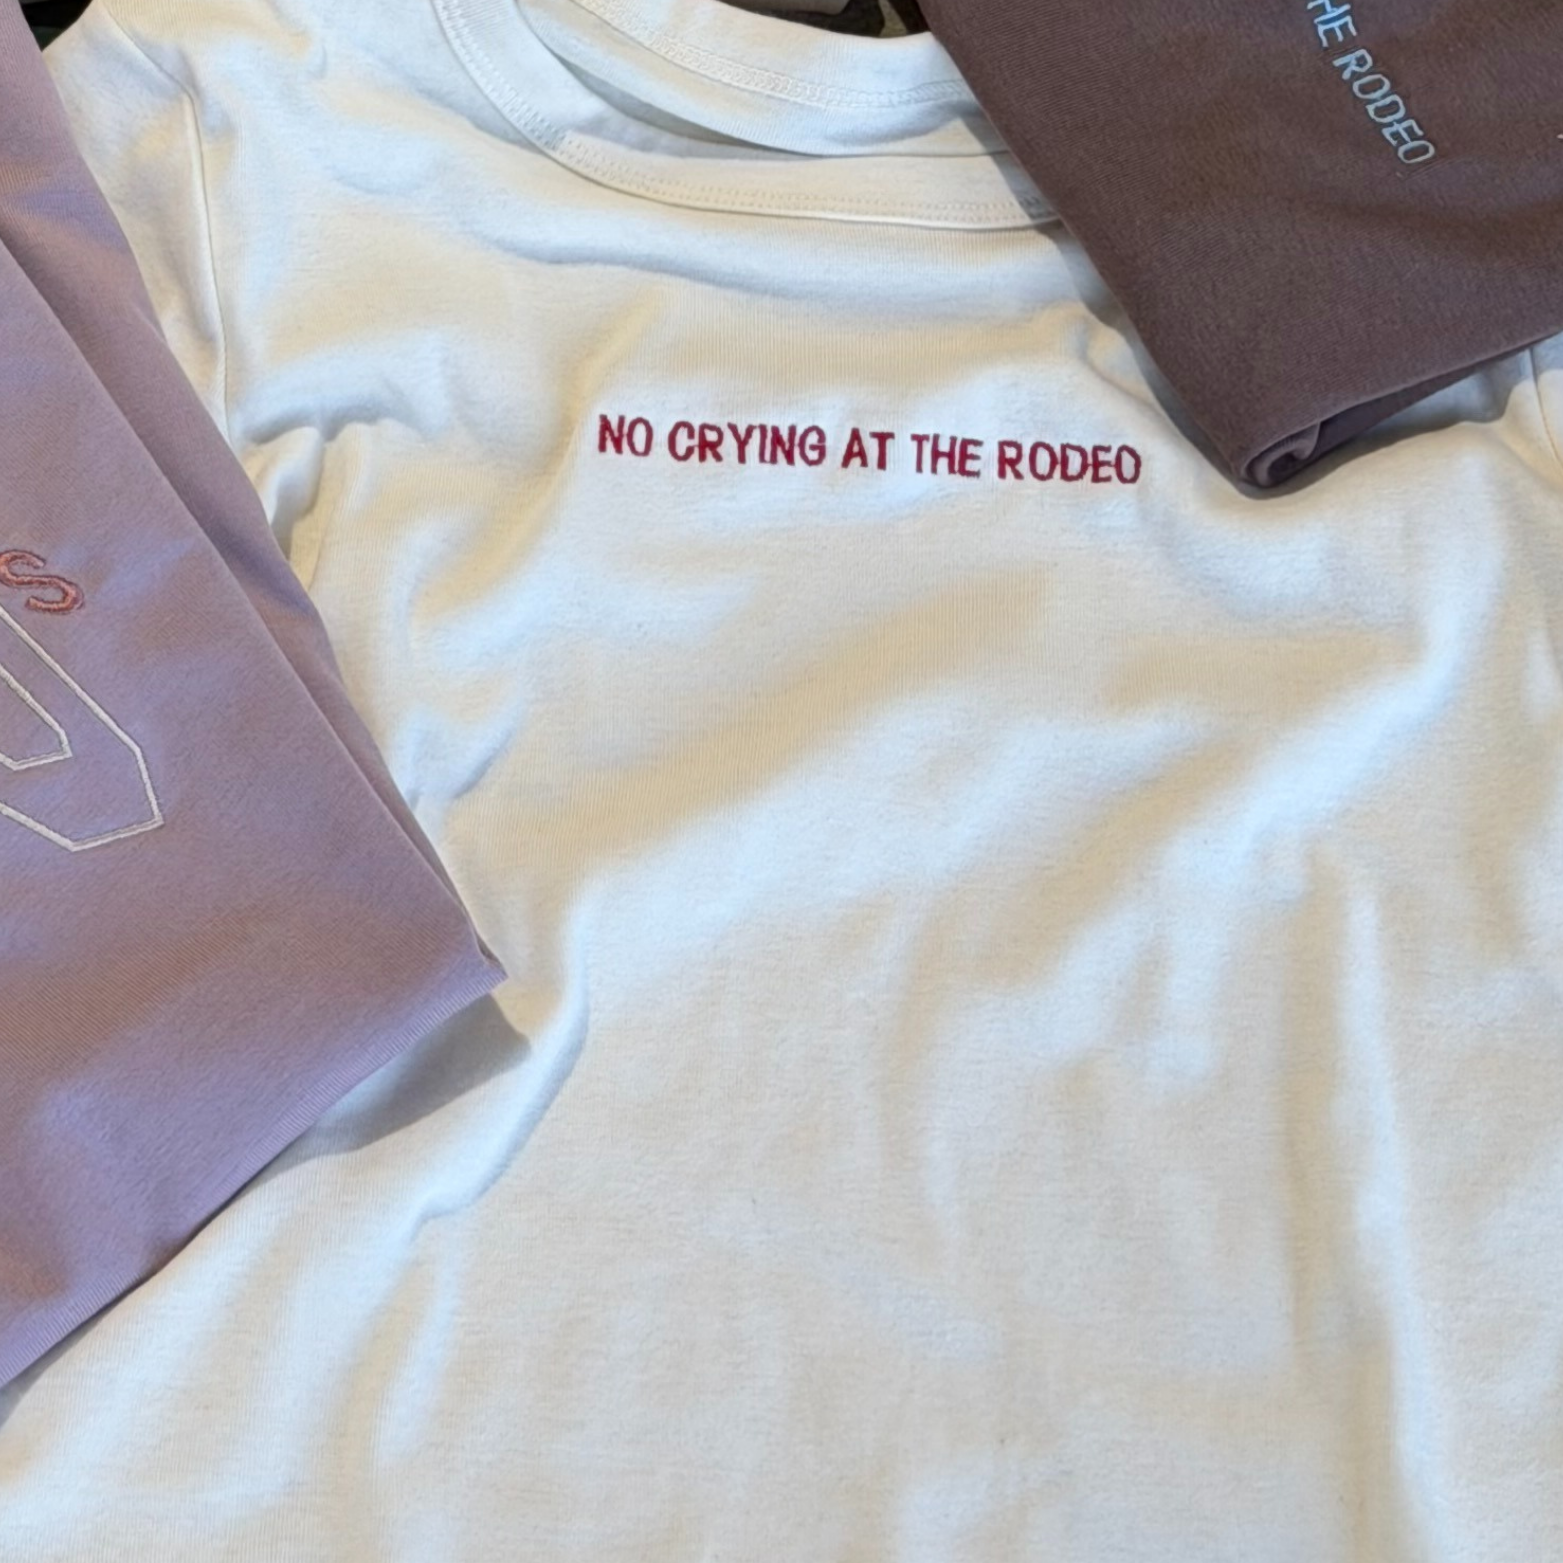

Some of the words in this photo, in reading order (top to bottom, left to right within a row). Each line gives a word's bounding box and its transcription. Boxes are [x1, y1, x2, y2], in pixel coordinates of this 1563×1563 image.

[1332, 48, 1435, 165] RODEO
[597, 414, 654, 457] NO
[667, 421, 827, 468] CRYING
[840, 427, 895, 471] AT
[910, 432, 984, 479] THE
[996, 439, 1143, 485] RODEO
